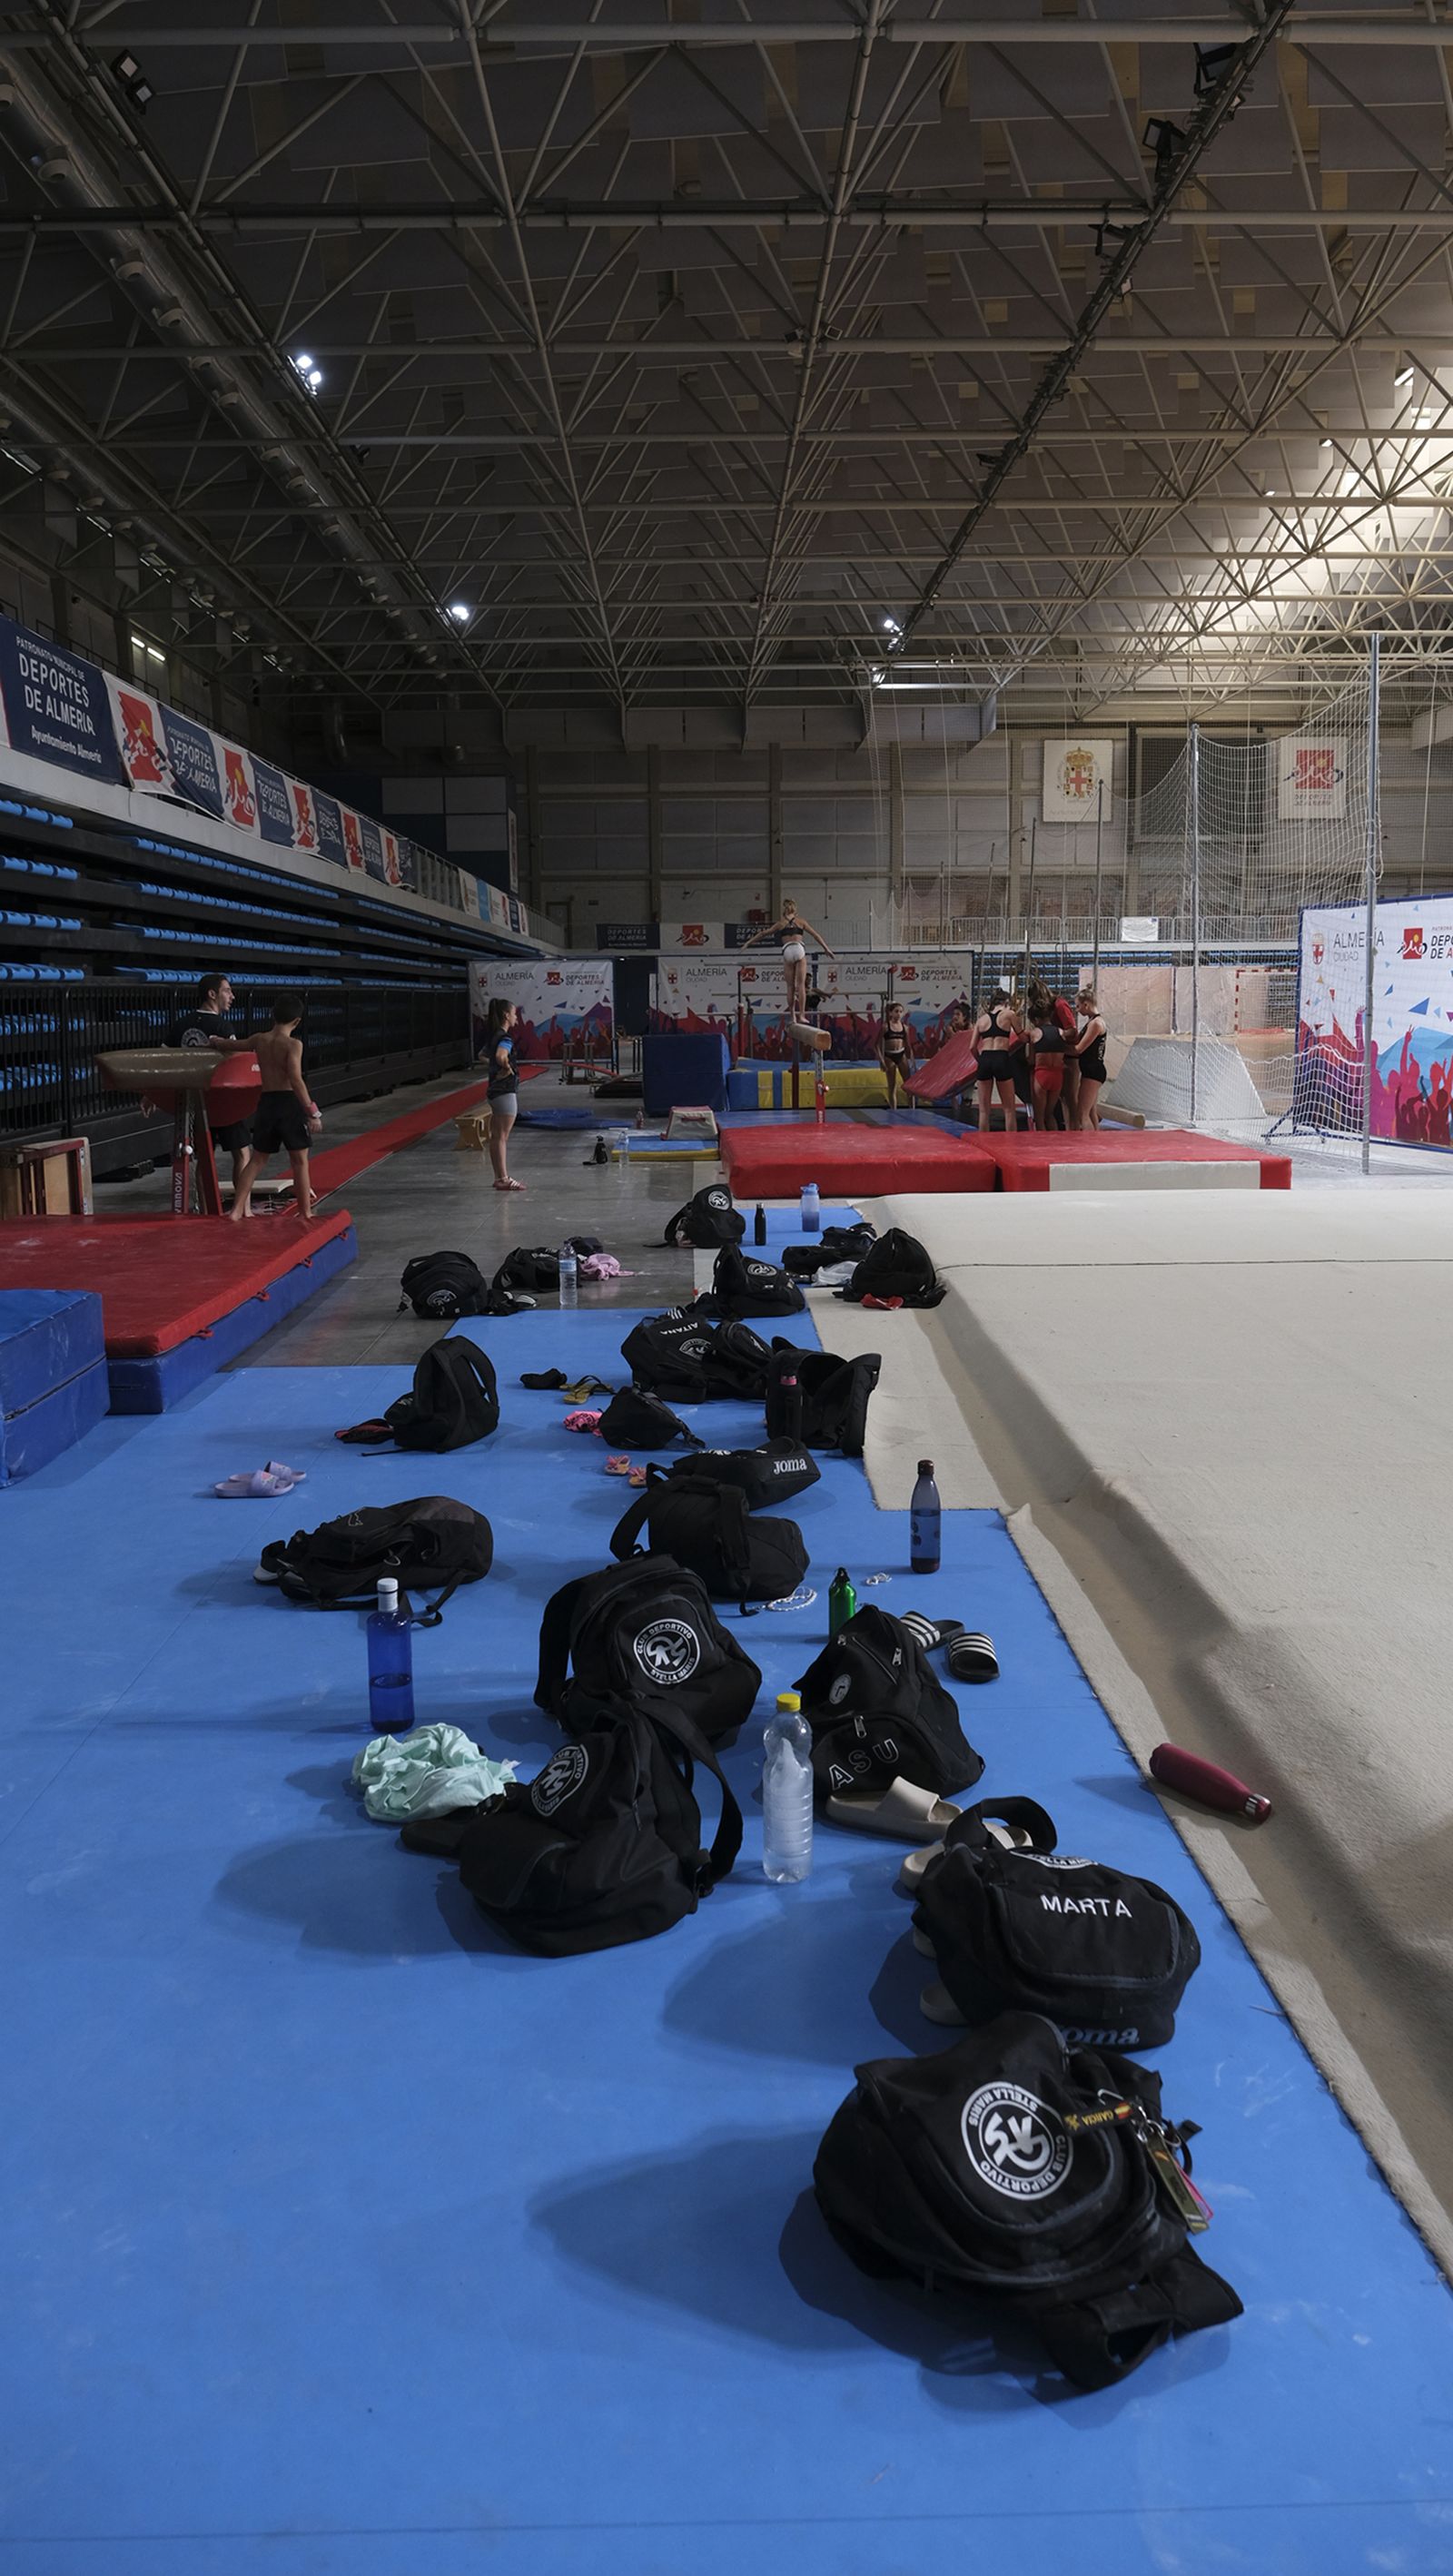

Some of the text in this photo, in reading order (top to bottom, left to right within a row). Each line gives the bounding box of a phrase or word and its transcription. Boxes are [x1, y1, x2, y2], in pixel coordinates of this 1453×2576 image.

[18, 652, 90, 708] DEPORTES
[25, 685, 44, 714] DE
[31, 725, 76, 755] Ayuntamiento
[1333, 927, 1385, 949] ALMEÍA
[1430, 948, 1444, 959] DE
[495, 970, 535, 981] ALMERÍA
[686, 966, 727, 976] ALMERÍA
[845, 964, 887, 974] ALMERÍA
[637, 1623, 693, 1654] CLUB DEPORTIVO
[650, 1657, 696, 1681] STELLA MARIS
[1040, 1893, 1133, 1918] MARTA
[1061, 2026, 1140, 2046] oma
[967, 2087, 1038, 2127] STELLA MARIS
[980, 2134, 1066, 2194] CLUB DEPORTIVO
